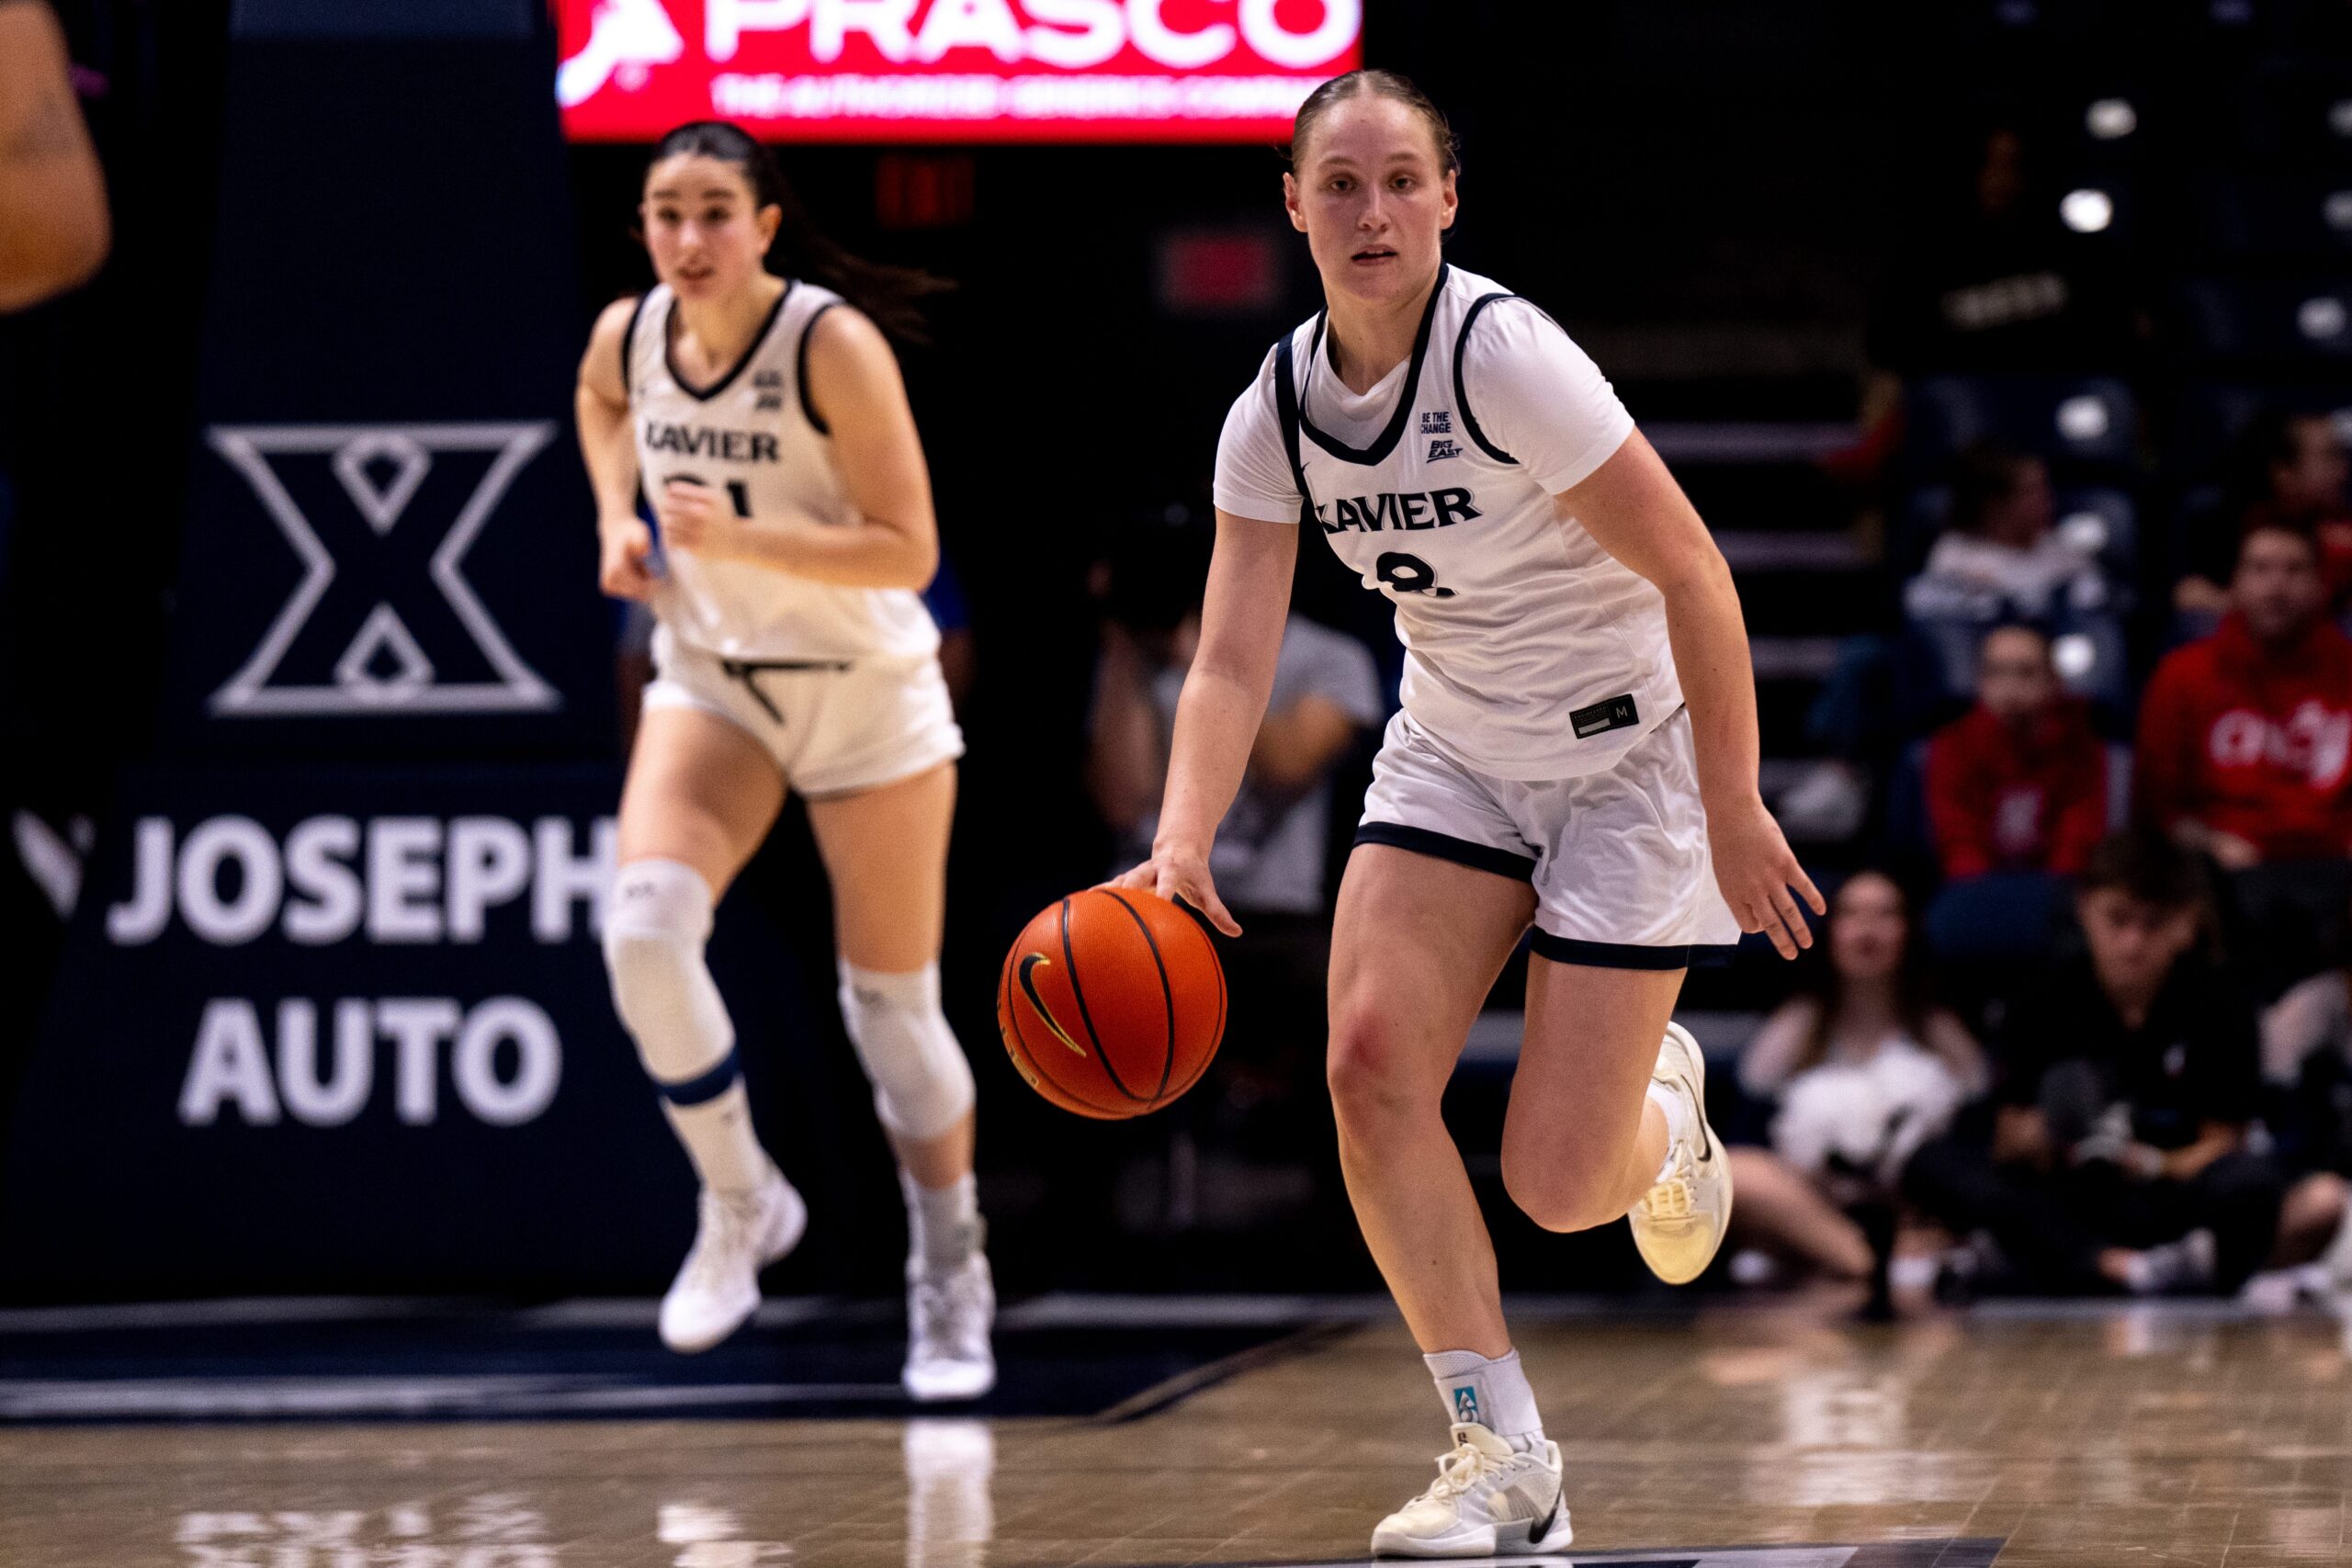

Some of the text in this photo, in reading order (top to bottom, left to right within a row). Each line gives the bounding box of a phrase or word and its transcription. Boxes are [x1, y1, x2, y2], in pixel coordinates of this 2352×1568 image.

[704, 0, 1362, 68] PRASCO
[1422, 412, 1449, 423] BE THE
[1420, 423, 1452, 434] CHANGE
[1430, 440, 1453, 449] BIG
[1428, 447, 1463, 458] EAST
[663, 471, 752, 519] 1
[1615, 705, 1628, 718] M
[106, 813, 619, 946] JOSEPH
[176, 994, 564, 1127] AUTO
